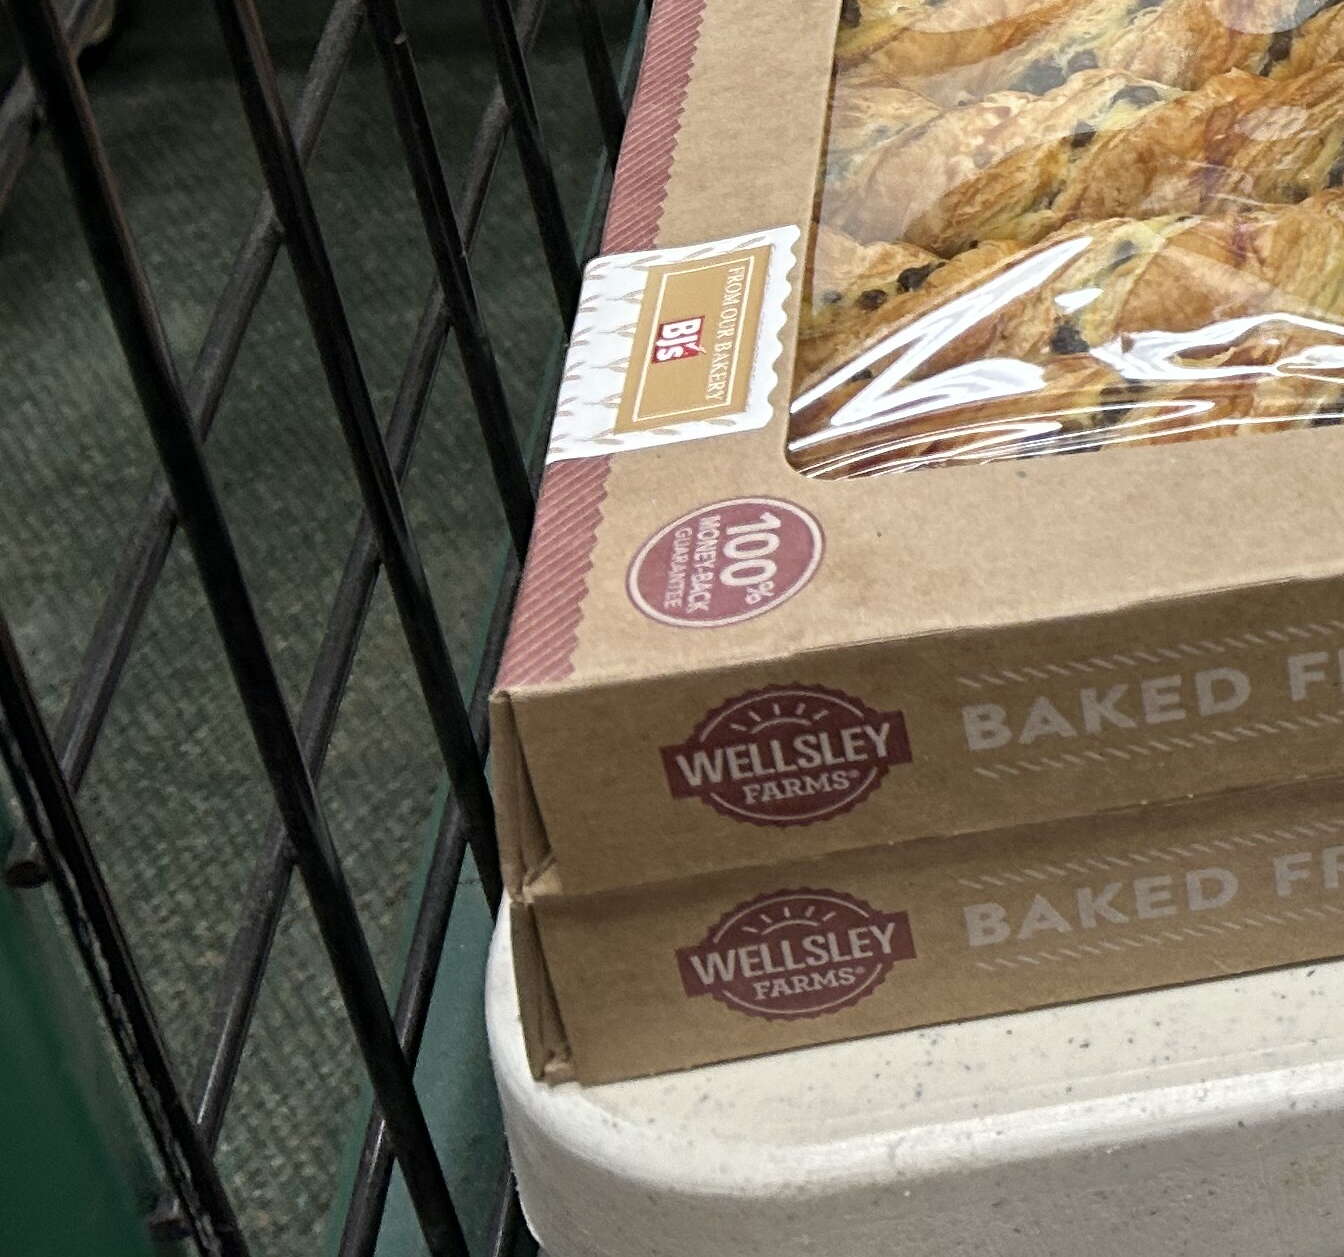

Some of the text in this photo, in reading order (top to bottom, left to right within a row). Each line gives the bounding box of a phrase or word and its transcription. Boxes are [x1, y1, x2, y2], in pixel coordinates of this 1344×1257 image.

[705, 266, 746, 401] FROM OUR BAKERY
[663, 527, 693, 609] GUARANTEE
[685, 515, 721, 613] MONEY-BACK
[719, 512, 781, 605] 100%
[960, 665, 1251, 752] BAKED
[675, 723, 892, 787] WELLSLEY
[963, 866, 1239, 947] BAKED
[689, 923, 897, 985] WELLSLEY
